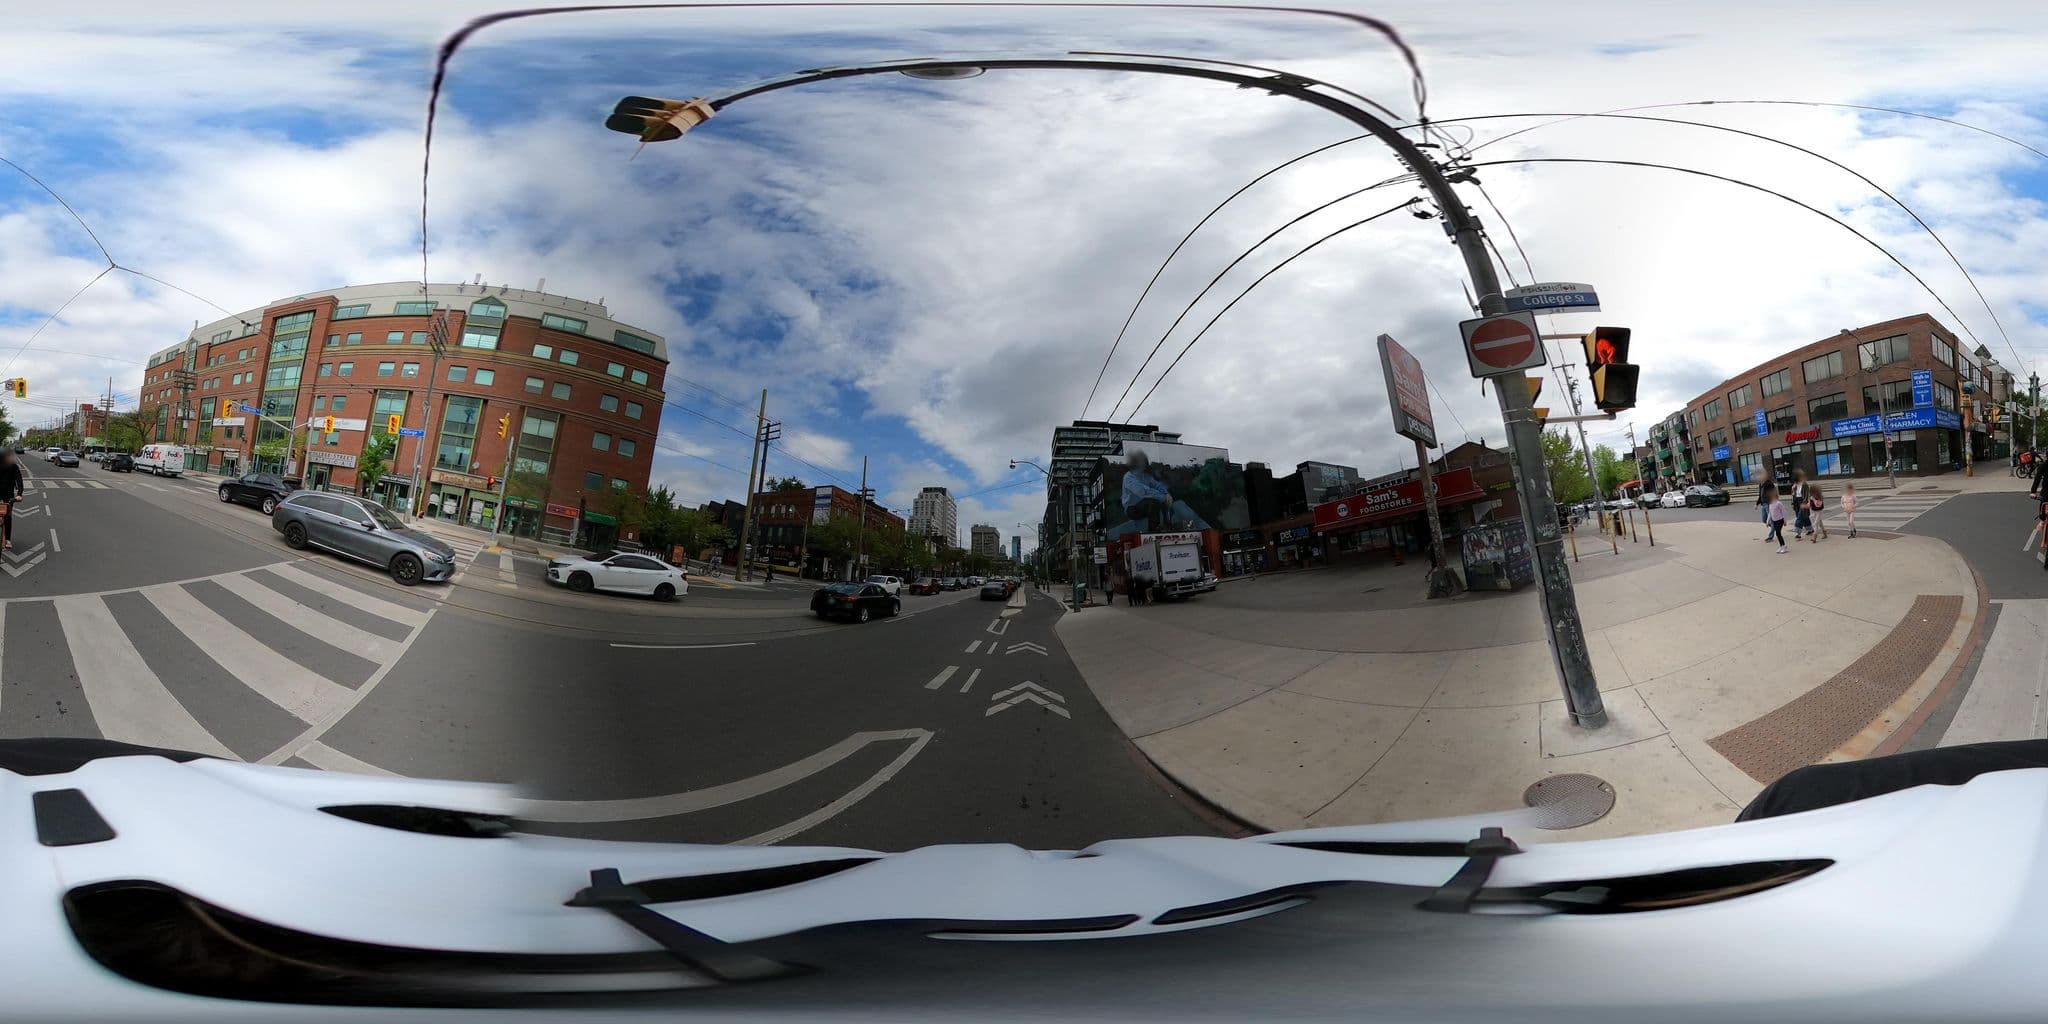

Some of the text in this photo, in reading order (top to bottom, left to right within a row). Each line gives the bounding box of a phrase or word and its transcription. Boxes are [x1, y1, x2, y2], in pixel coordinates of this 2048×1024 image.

[1522, 294, 1584, 305] College St
[1834, 423, 1856, 431] Walk-In
[1365, 489, 1399, 504] Sam's
[1280, 528, 1292, 542] pet
